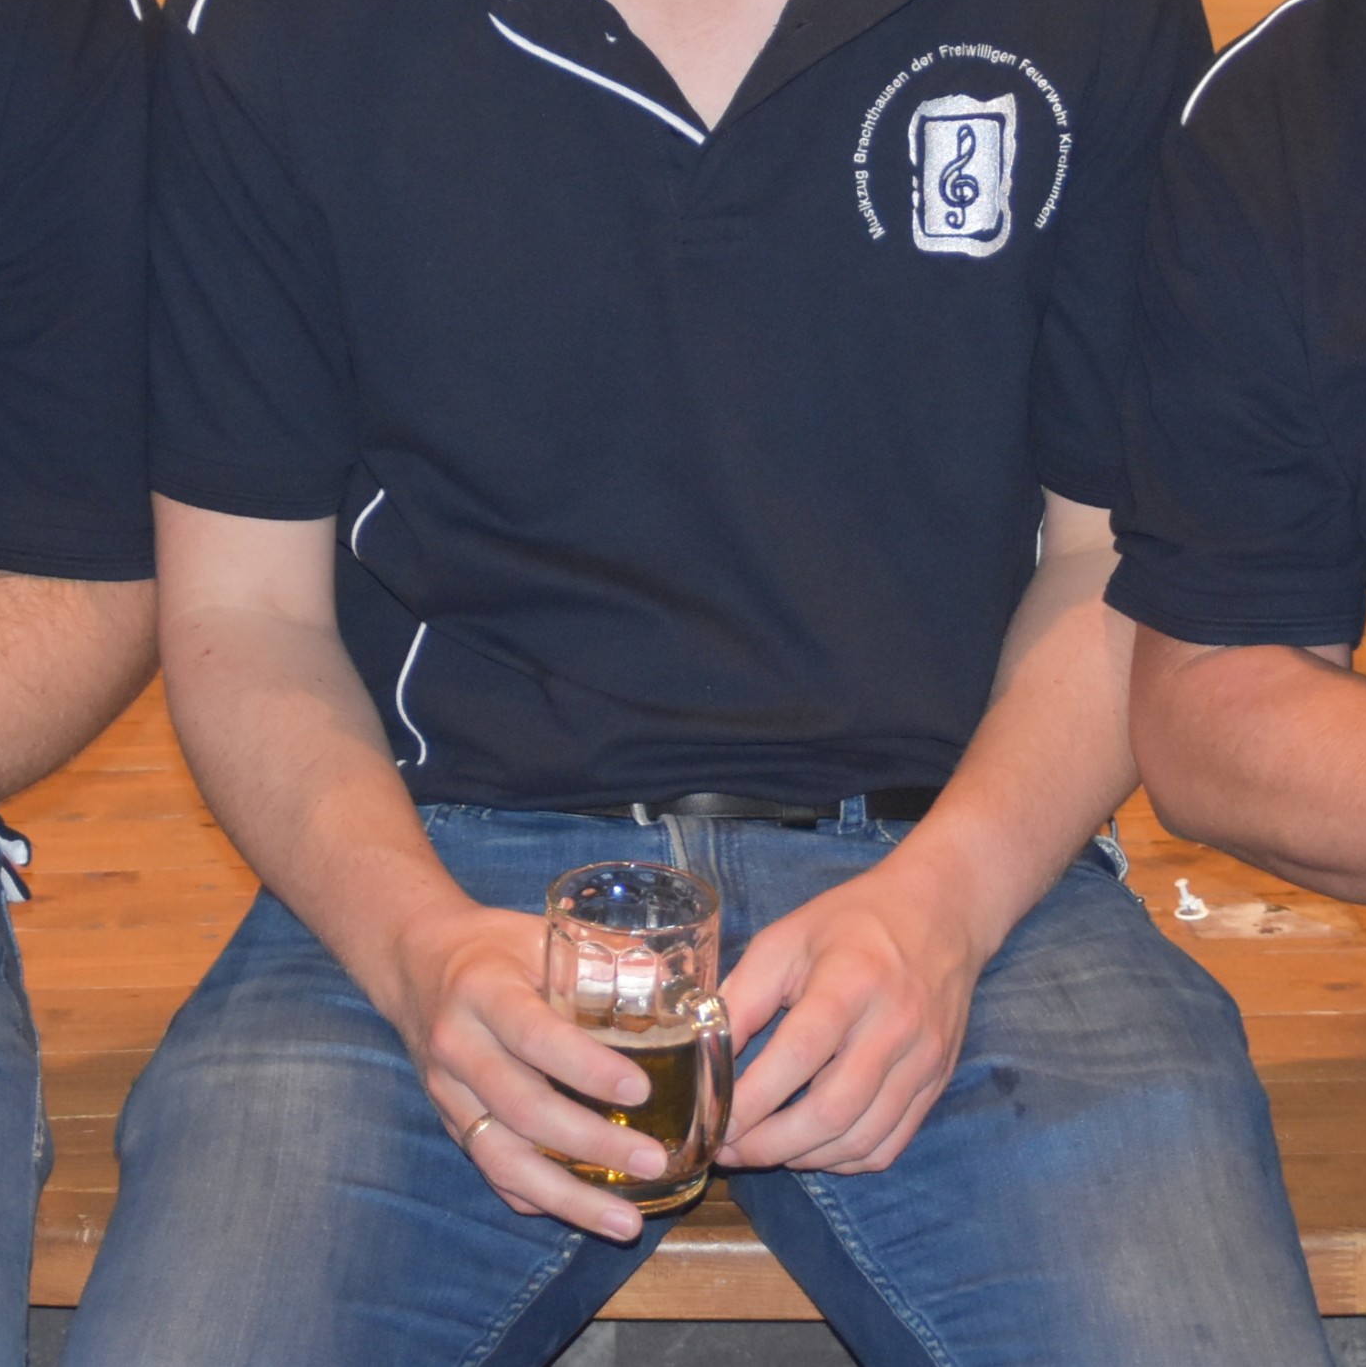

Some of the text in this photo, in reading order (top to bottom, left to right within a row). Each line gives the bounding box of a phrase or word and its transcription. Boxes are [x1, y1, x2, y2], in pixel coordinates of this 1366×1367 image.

[853, 42, 1073, 240] Musikzug Brachthausen der Freiwilligen Feuerwehr Kirchhundem
